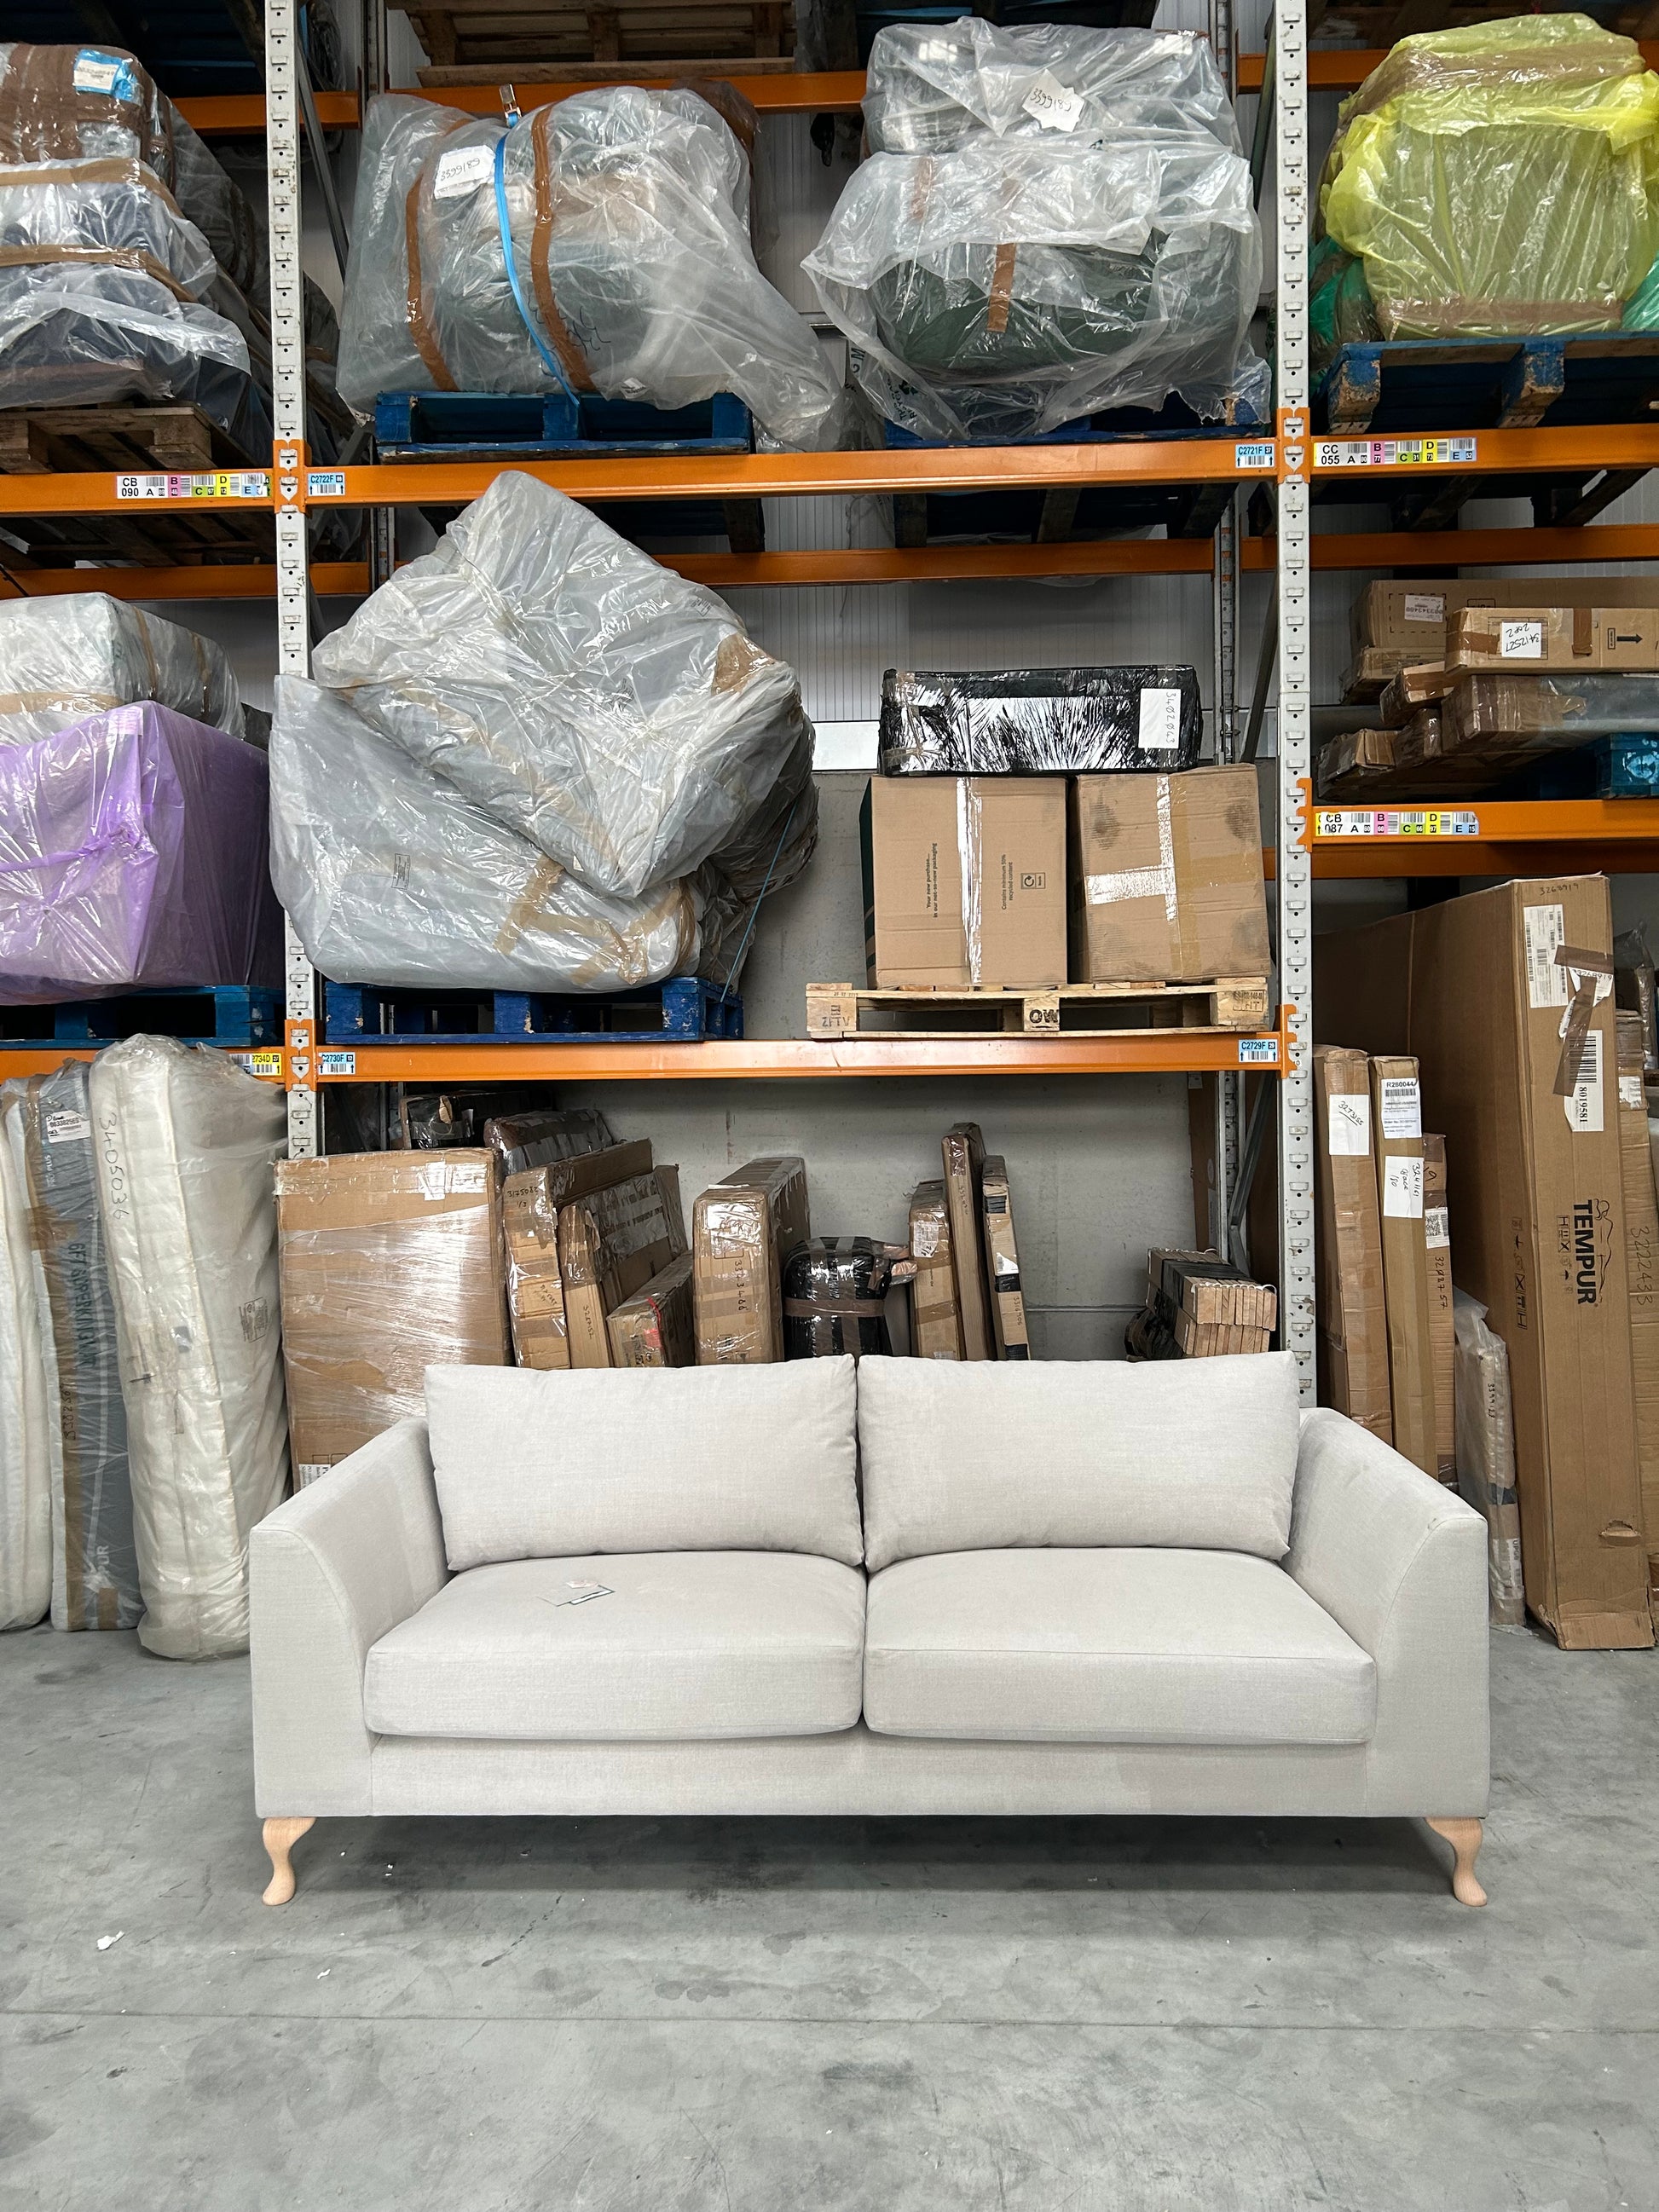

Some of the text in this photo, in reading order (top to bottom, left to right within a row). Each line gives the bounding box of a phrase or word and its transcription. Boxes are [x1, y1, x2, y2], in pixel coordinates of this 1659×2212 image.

[1238, 446, 1263, 455] C2721F
[1322, 444, 1338, 453] CC
[1321, 455, 1340, 465] 055
[122, 476, 227, 487] CB B D
[310, 474, 334, 483] C2722F
[121, 488, 139, 496] 090
[244, 486, 251, 494] E
[1326, 813, 1342, 823] CB
[1324, 824, 1343, 833] 087
[1402, 824, 1411, 833] C
[1455, 824, 1463, 833] E
[1241, 1041, 1267, 1049] C2729F
[1579, 1086, 1588, 1123] 8019581
[98, 1112, 130, 1220] 3405036
[1573, 1199, 1597, 1304] TEMPUR
